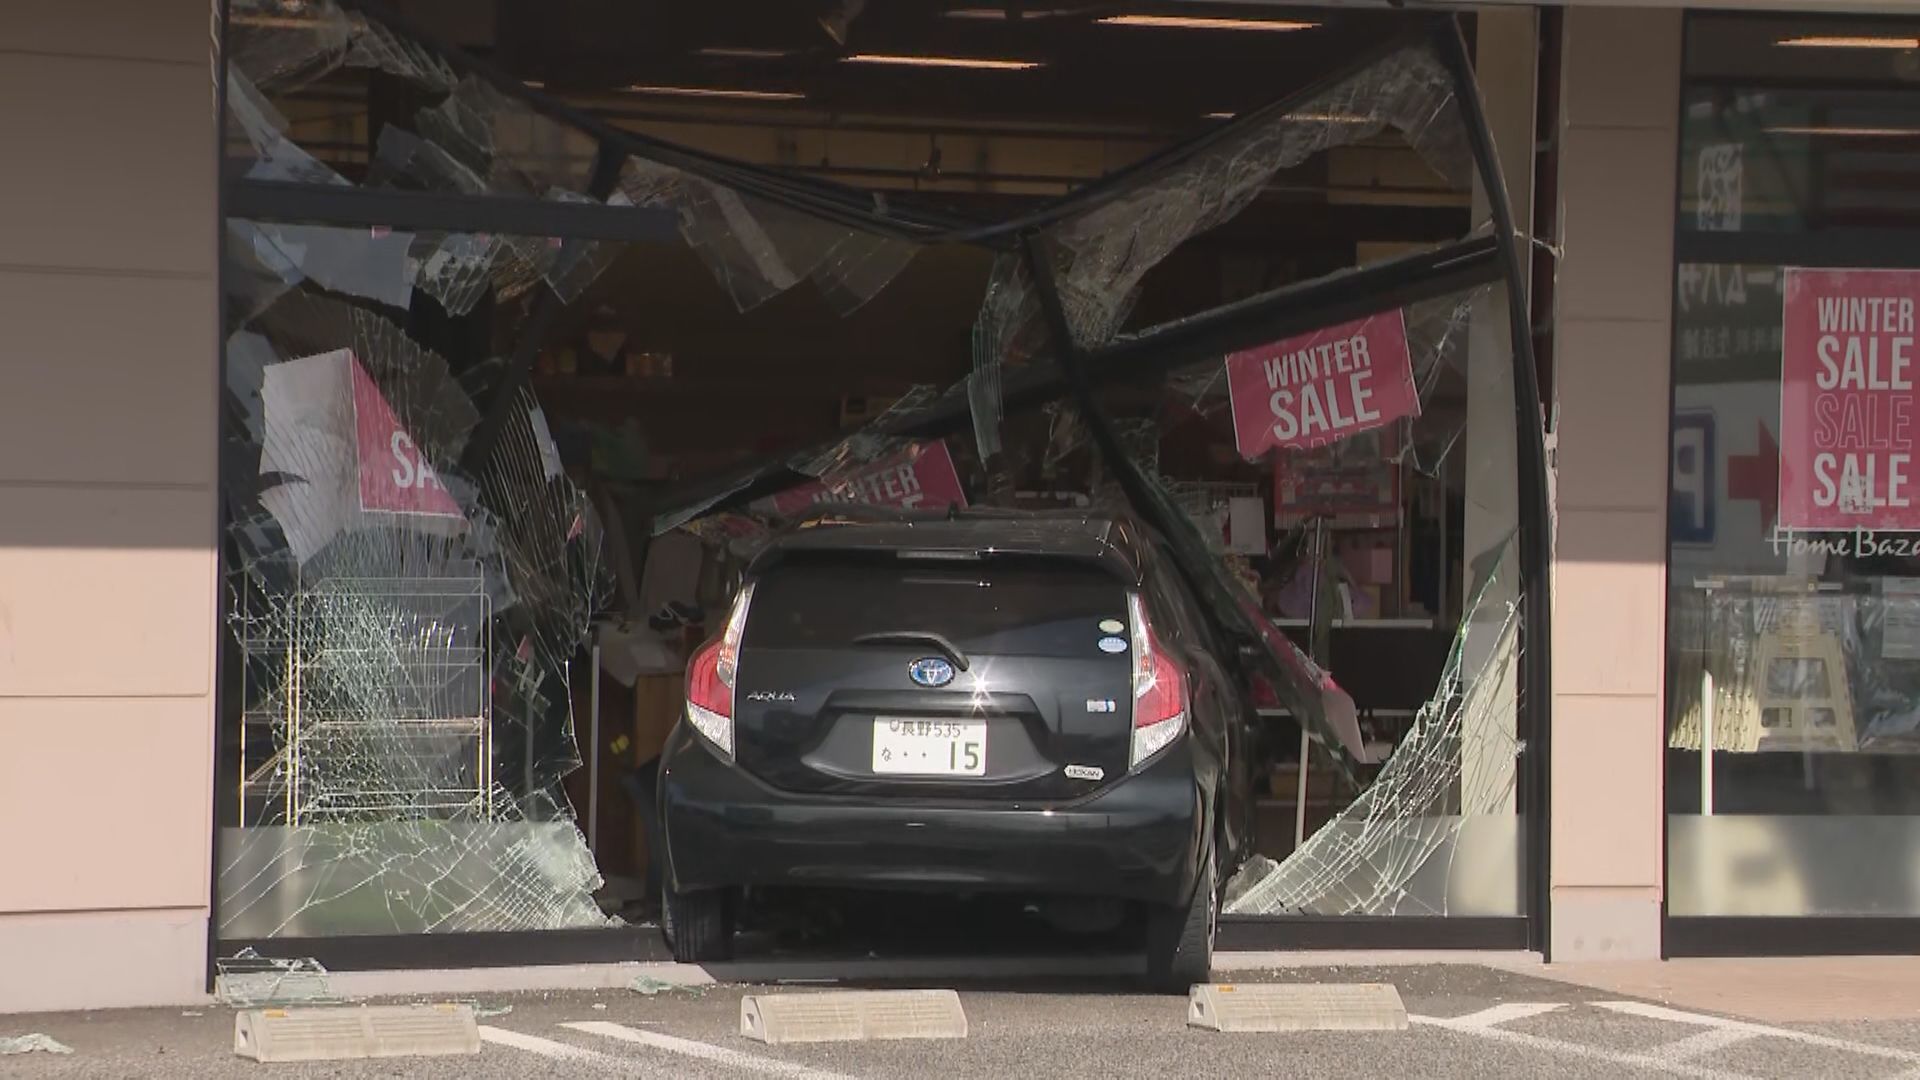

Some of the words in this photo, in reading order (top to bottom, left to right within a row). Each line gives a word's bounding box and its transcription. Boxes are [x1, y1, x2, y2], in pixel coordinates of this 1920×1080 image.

[1818, 297, 1914, 333] WINTER
[1264, 335, 1371, 389] WINTER
[1816, 335, 1914, 391] SALE
[1269, 370, 1380, 441] SALE
[1813, 393, 1913, 449] SALE
[391, 431, 446, 489] SA
[1813, 453, 1911, 507] SALE
[1765, 525, 1851, 557] Home
